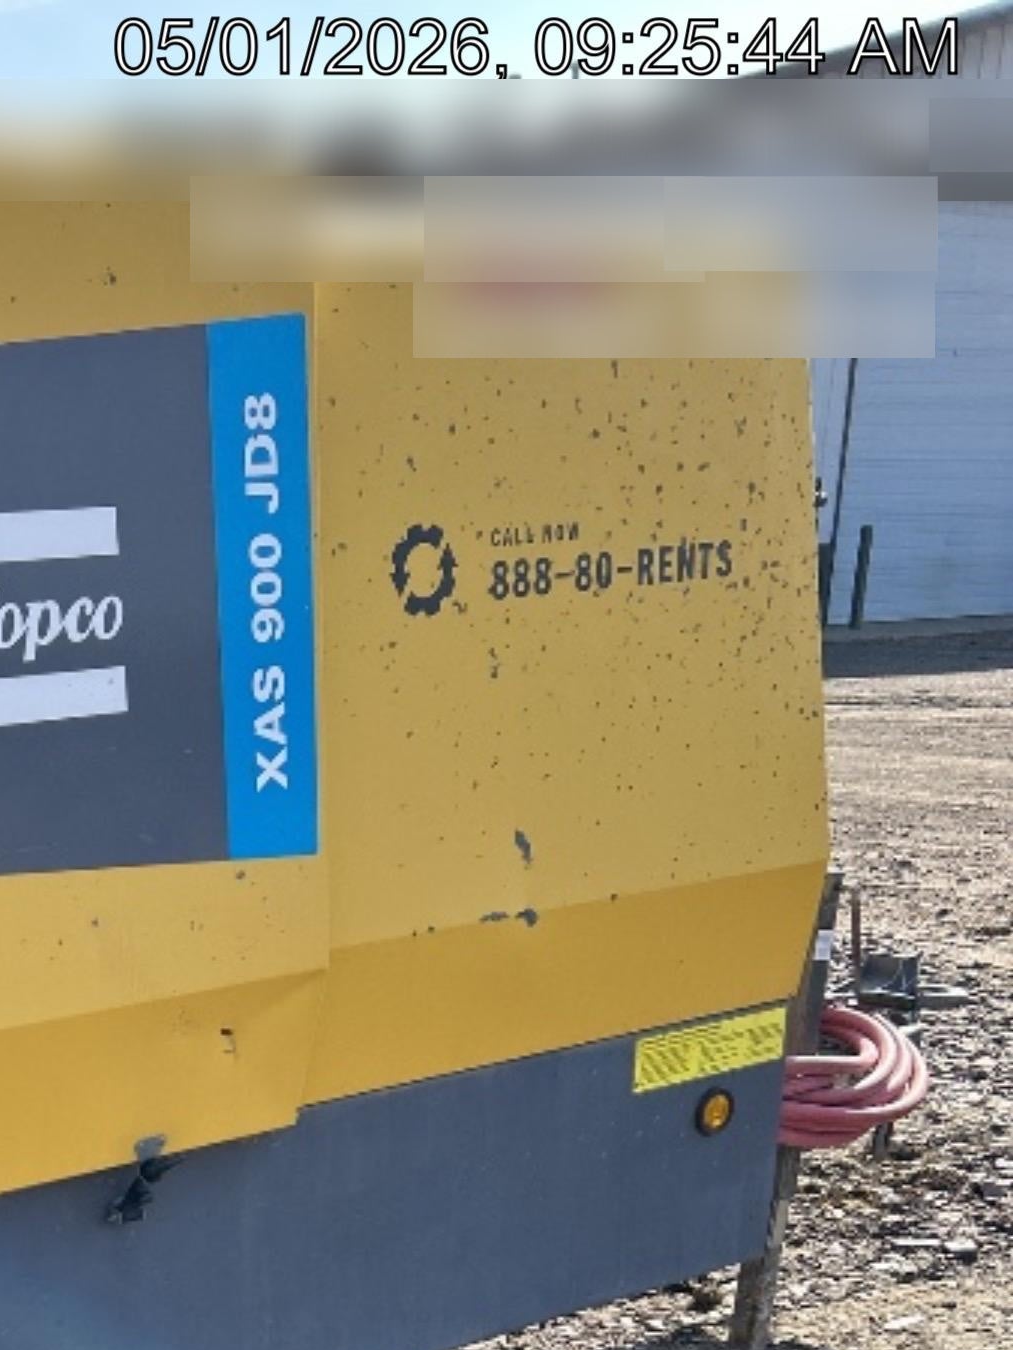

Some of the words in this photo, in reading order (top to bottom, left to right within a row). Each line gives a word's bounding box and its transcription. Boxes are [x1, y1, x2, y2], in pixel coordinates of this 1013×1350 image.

[243, 391, 281, 514] JD8
[248, 532, 285, 644] 900
[490, 526, 535, 547] CALL
[541, 522, 580, 544] NOW
[490, 537, 733, 600] 888-80-RENTS
[253, 664, 289, 793] XAS
